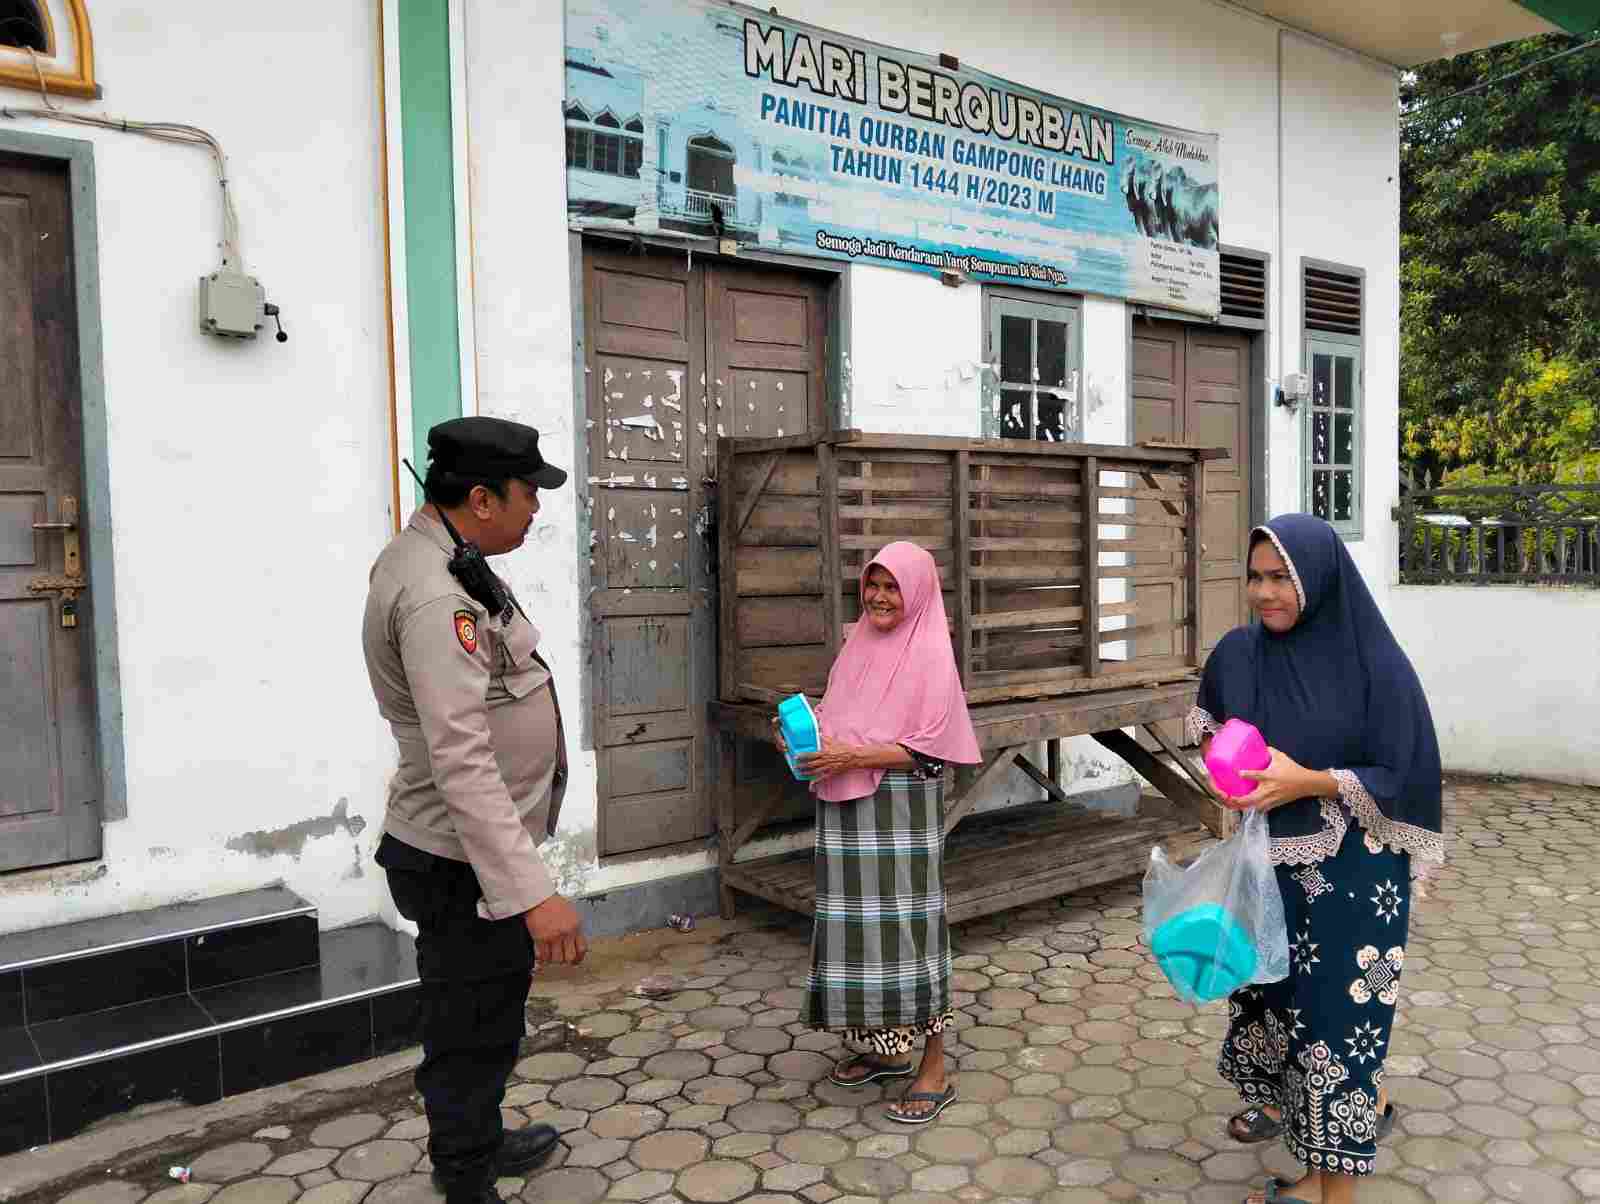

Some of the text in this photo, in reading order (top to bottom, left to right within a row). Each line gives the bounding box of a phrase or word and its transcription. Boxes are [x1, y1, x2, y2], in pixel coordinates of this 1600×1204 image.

[744, 18, 1114, 165] MARI BERQURBAN
[761, 93, 1105, 195] PANITIA QURBAN GAMPONG LHANG
[831, 144, 1054, 214] TAHUN 1444 H/2023 M
[816, 230, 862, 256] Semoga
[863, 237, 887, 257] Jadi
[888, 243, 944, 266] Kendaraan
[944, 251, 969, 273] Yang
[970, 256, 1018, 277] Sempurna
